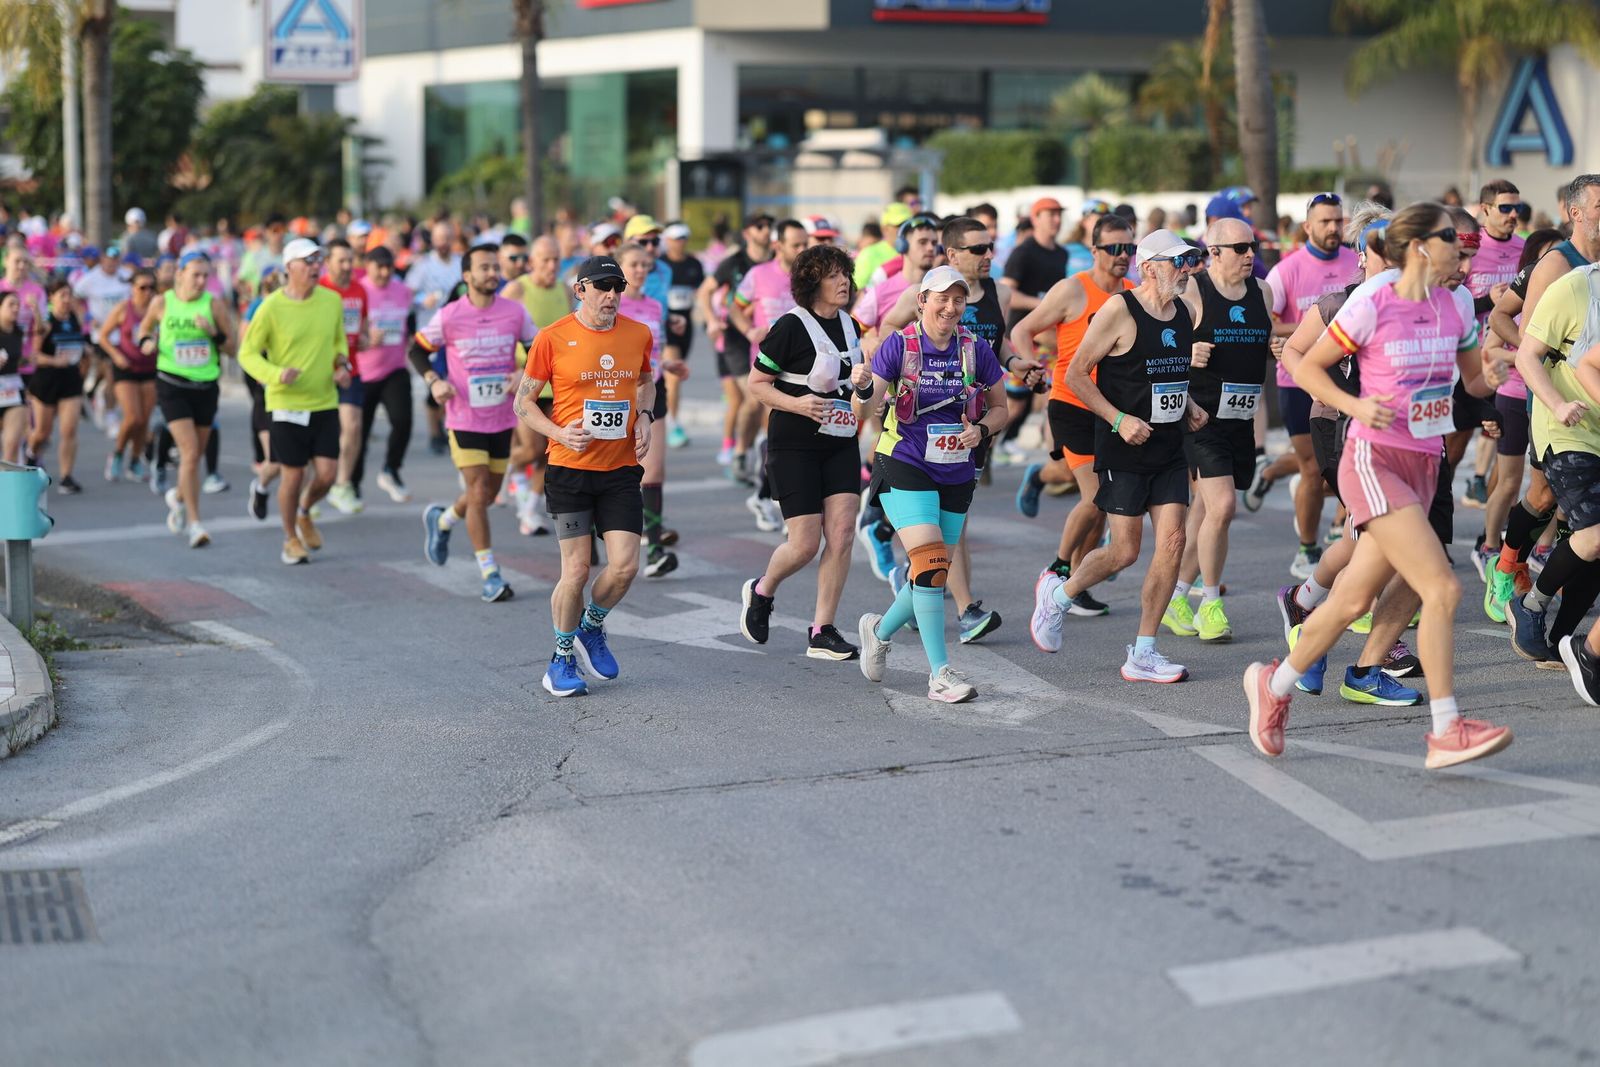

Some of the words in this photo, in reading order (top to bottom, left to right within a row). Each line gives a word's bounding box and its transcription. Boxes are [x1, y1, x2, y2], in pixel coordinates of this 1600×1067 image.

[1214, 328, 1267, 336] MONKSTOWN
[1146, 357, 1191, 366] MONKSTOW
[580, 371, 632, 380] BENIDORM
[1146, 365, 1184, 374] SPARTANS
[477, 383, 503, 396] 175
[1160, 393, 1184, 411] 930
[1227, 394, 1256, 409] 445
[1411, 398, 1450, 422] 2496
[591, 412, 623, 427] 338
